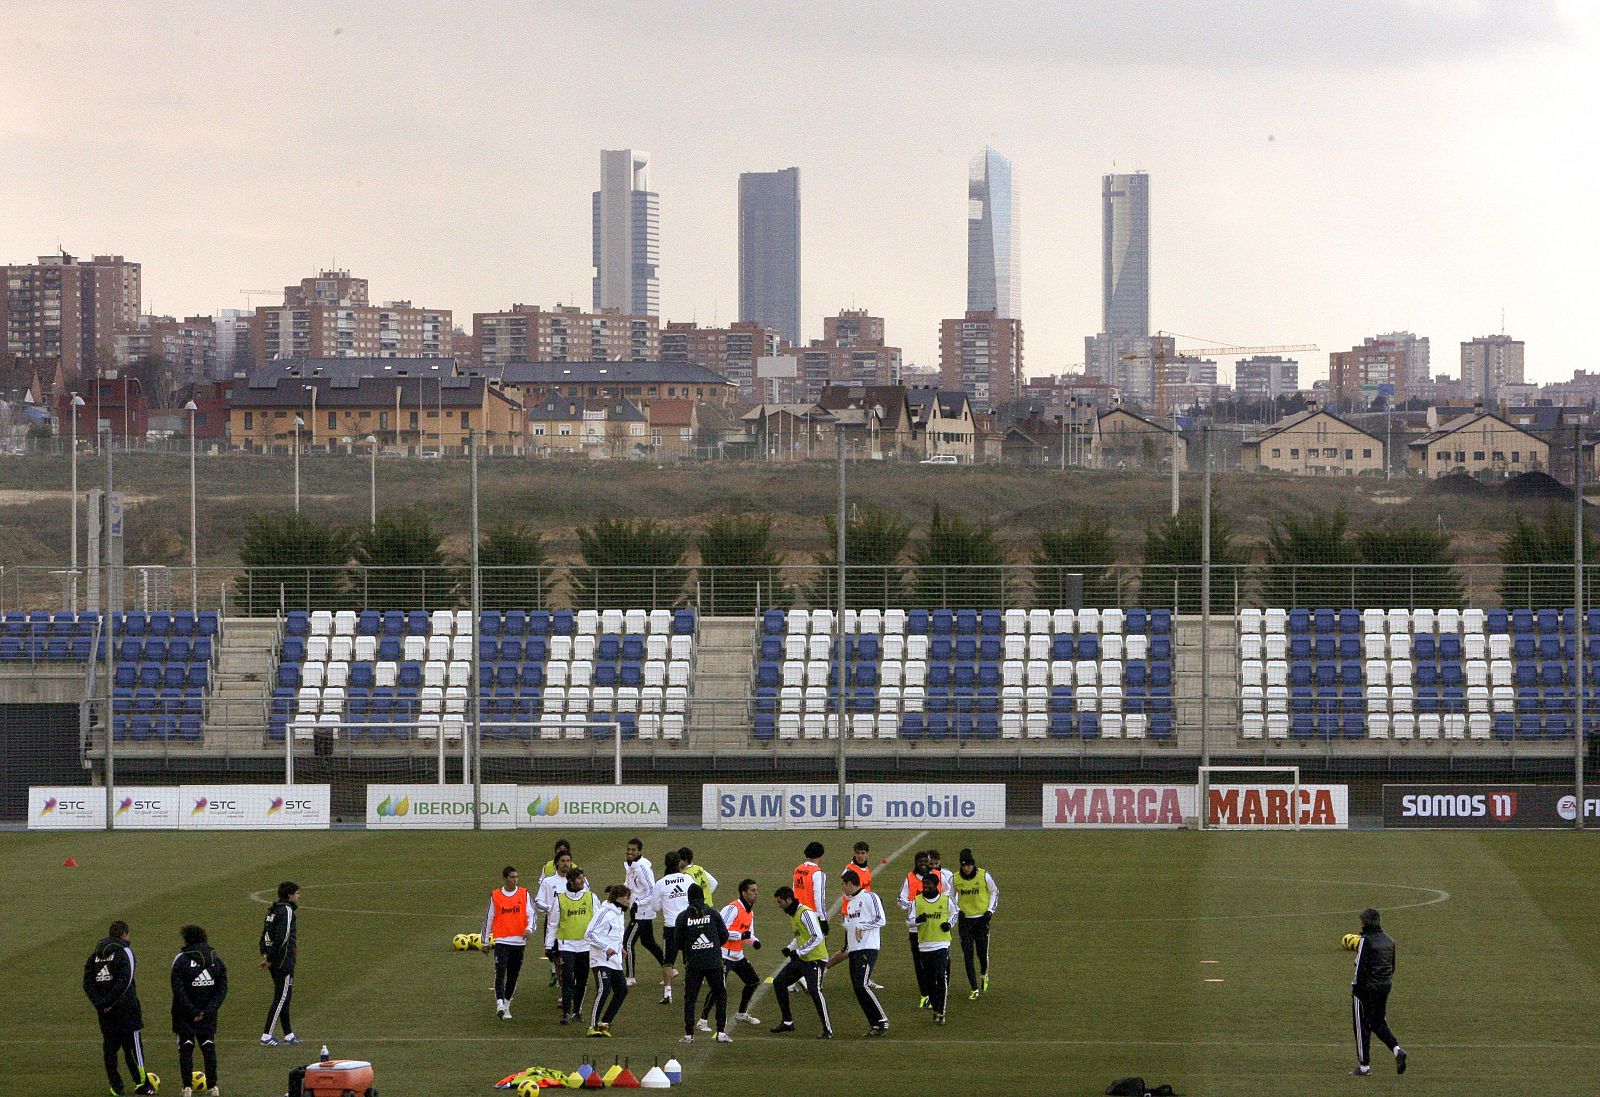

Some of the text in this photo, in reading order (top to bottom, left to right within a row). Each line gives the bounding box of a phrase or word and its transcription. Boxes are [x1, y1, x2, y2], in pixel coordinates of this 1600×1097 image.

[59, 801, 85, 810] STC
[134, 801, 161, 810] STC
[209, 801, 236, 810] STC
[285, 800, 312, 809] STC
[413, 802, 510, 815] IBERDROLA
[564, 801, 660, 815] IBERDROLA
[720, 794, 976, 818] SAMSUNG mobile
[1054, 788, 1183, 824] MARCA
[1208, 789, 1336, 825] MARCA
[1492, 795, 1511, 817] 11
[1562, 800, 1576, 809] EA
[664, 877, 685, 886] bwin
[501, 905, 521, 914] bwin
[567, 907, 586, 917] bwin
[687, 914, 711, 927] bwin
[692, 941, 714, 950] adidas
[191, 979, 215, 987] adidas
